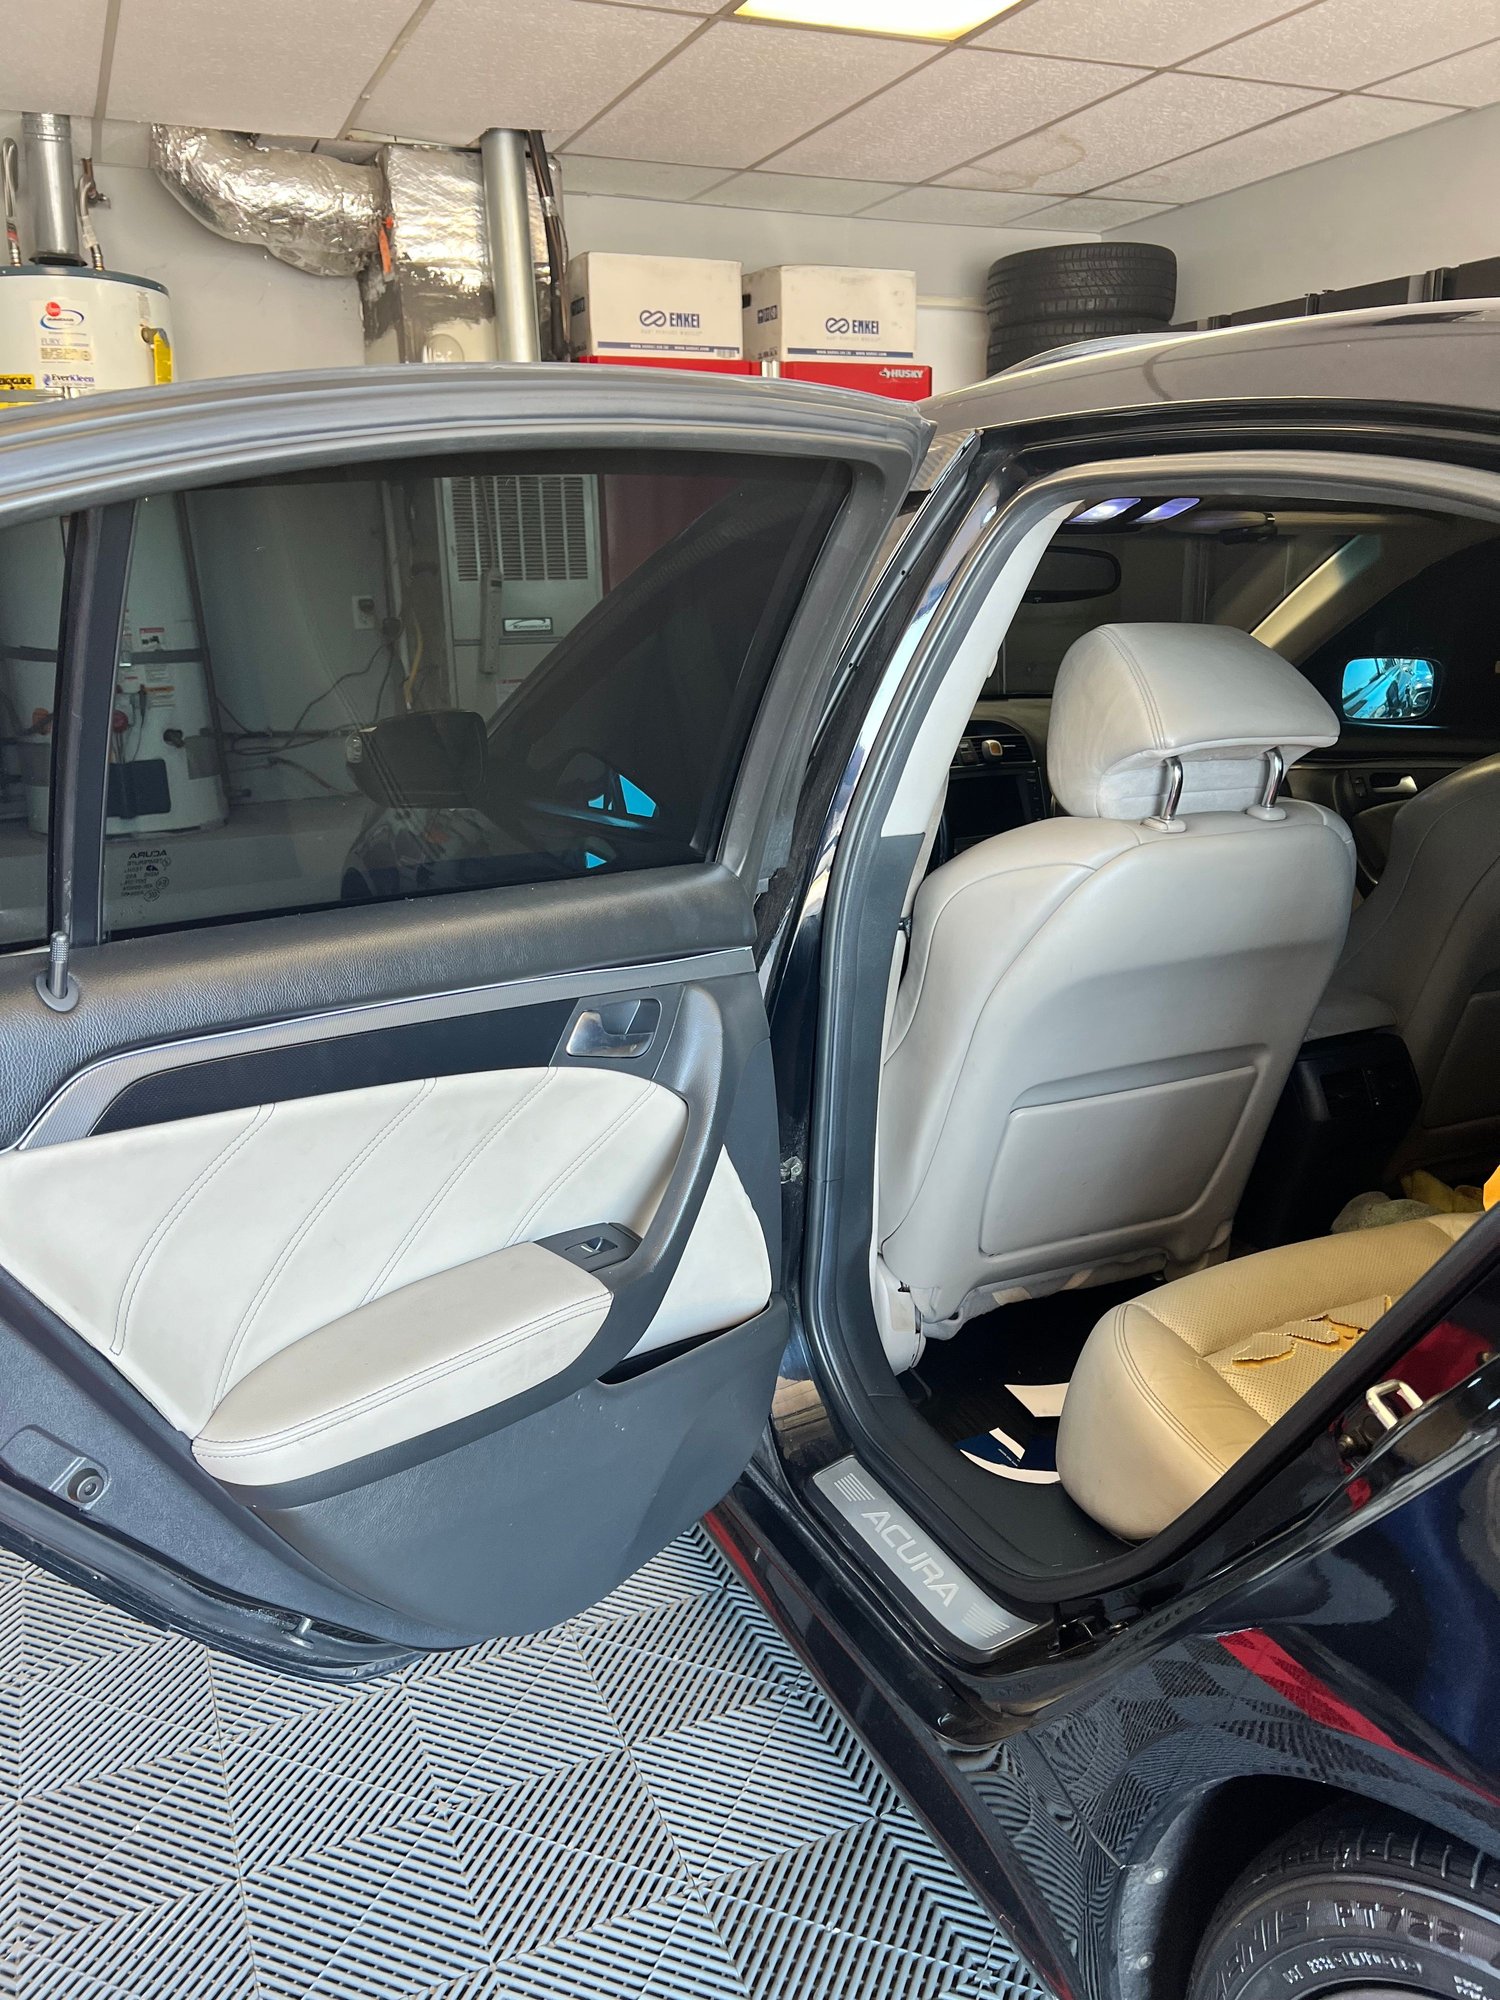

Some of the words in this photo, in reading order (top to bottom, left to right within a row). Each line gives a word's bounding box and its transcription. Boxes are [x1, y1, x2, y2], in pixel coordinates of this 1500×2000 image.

[669, 312, 700, 329] ENKEI
[852, 319, 879, 335] ENKEI
[52, 373, 95, 383] EverKleen
[891, 368, 924, 379] HUSKY
[861, 1512, 960, 1607] ACURA
